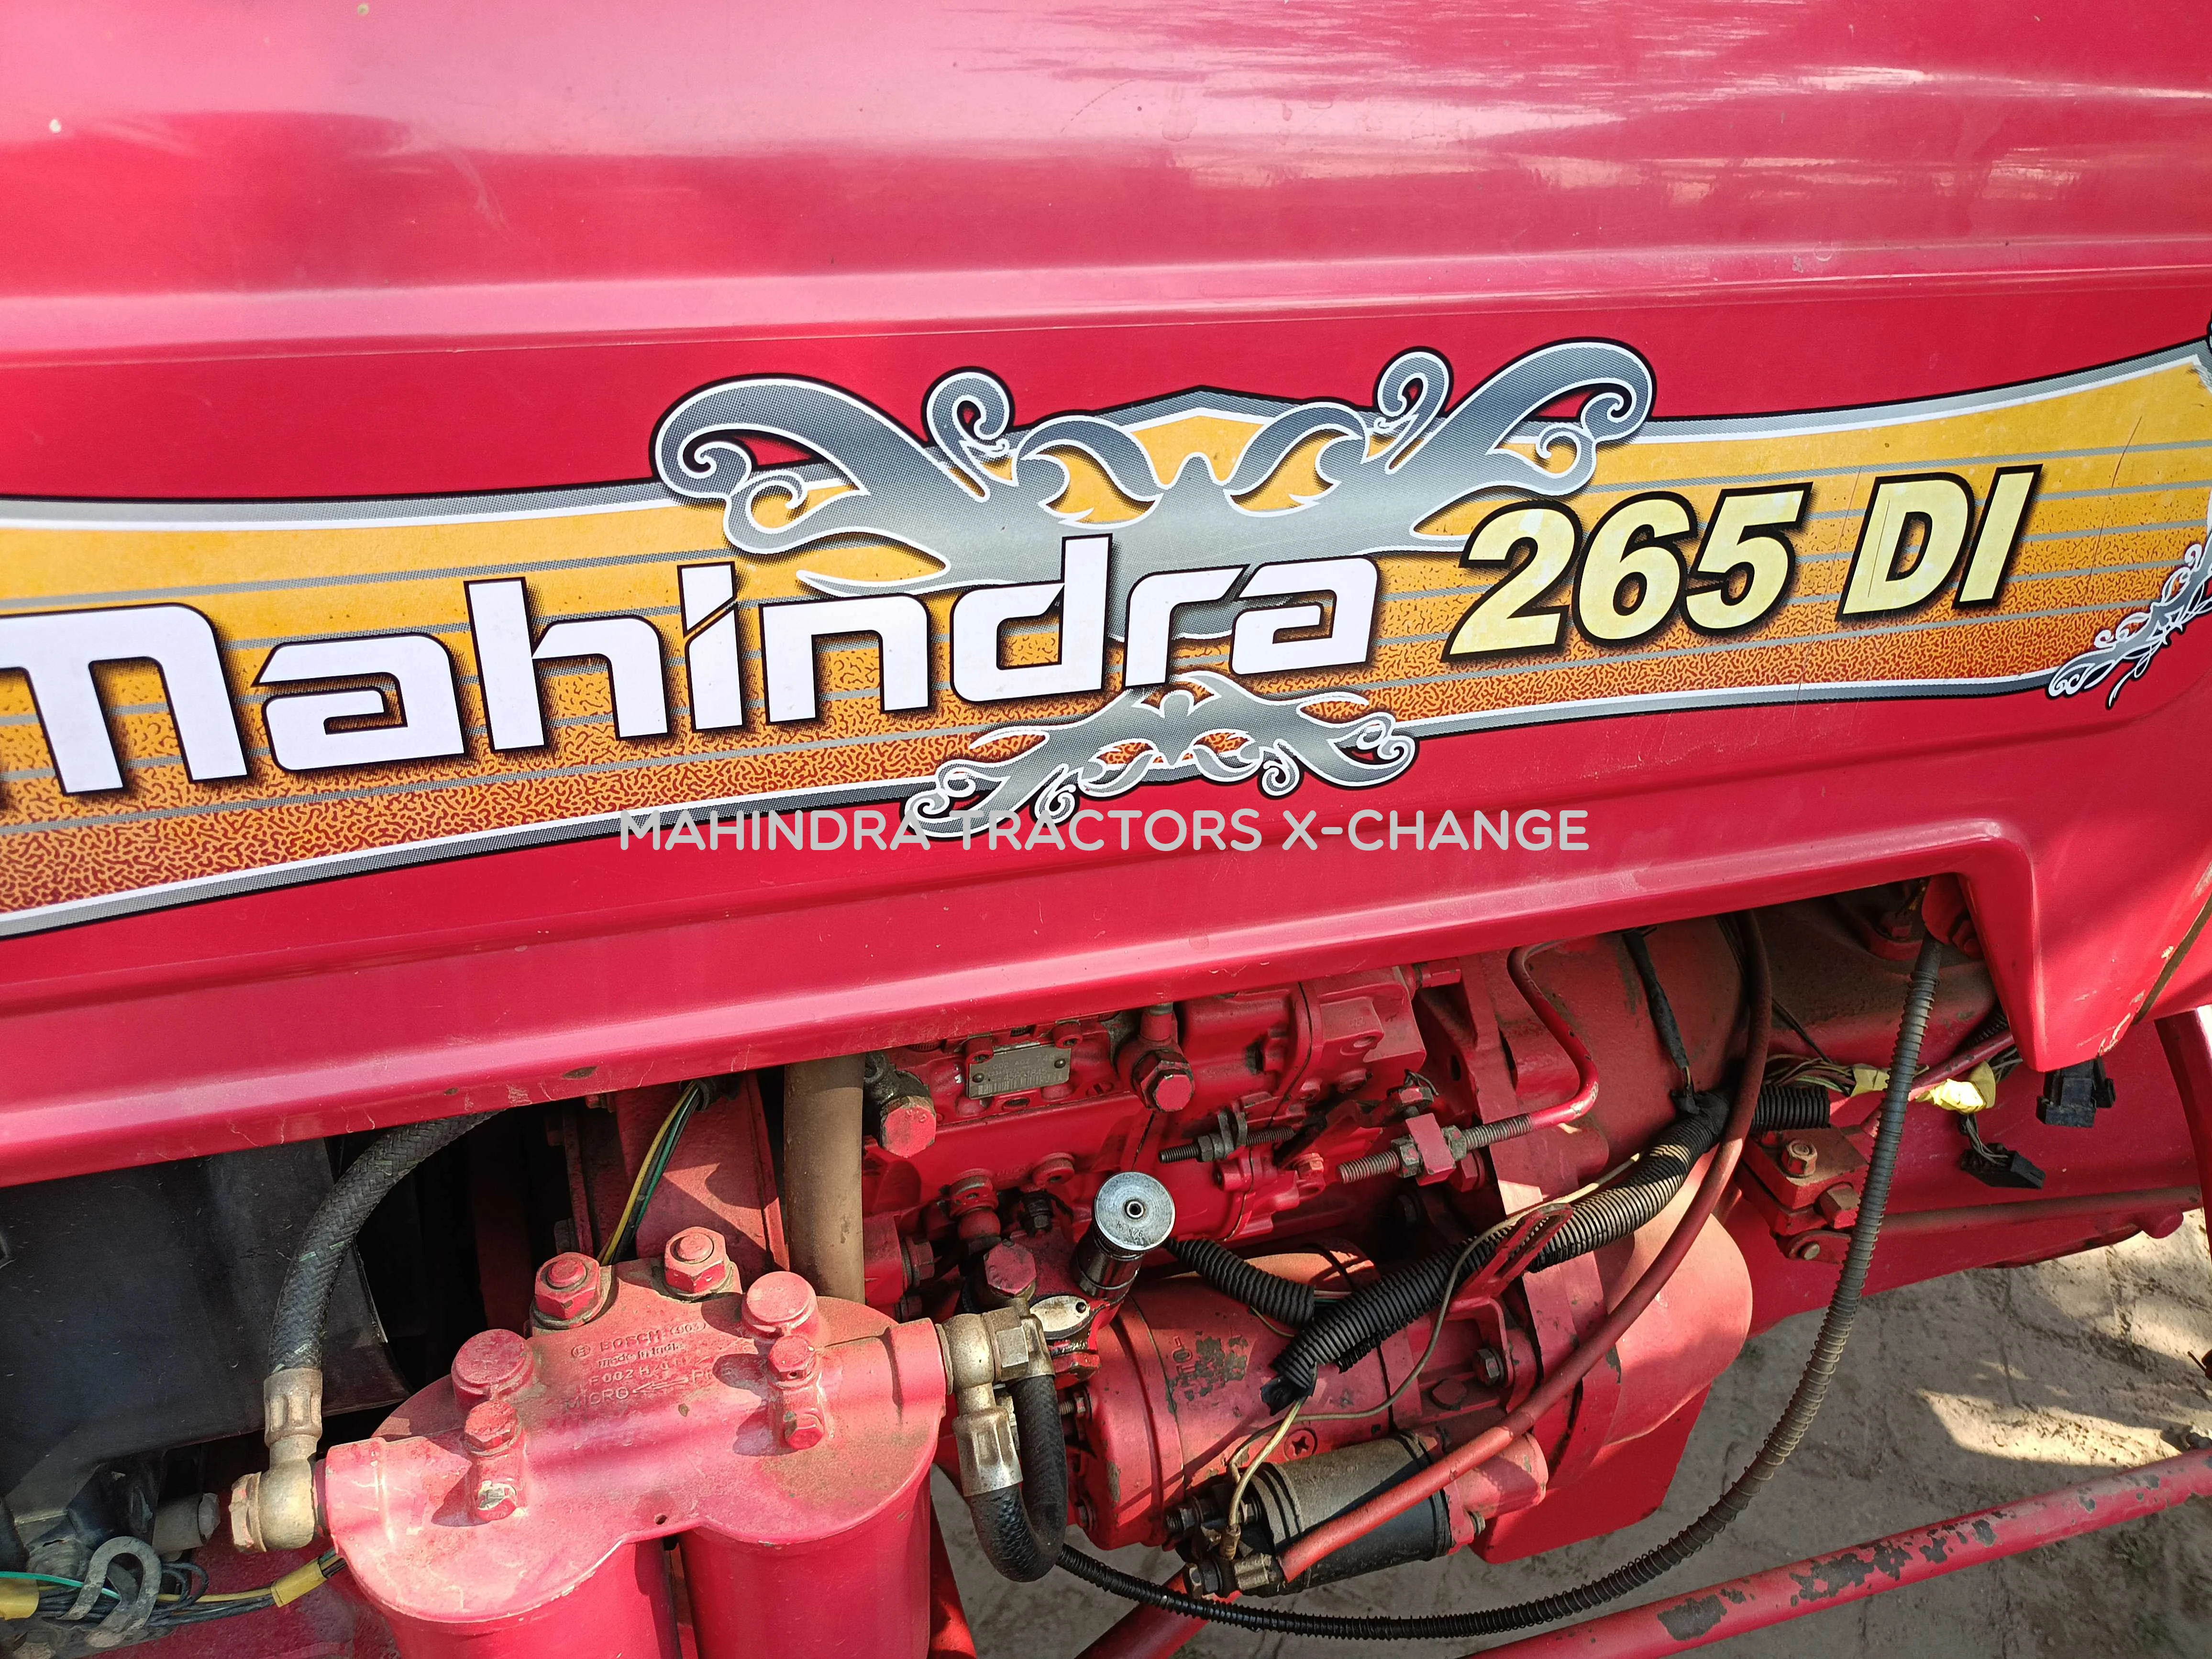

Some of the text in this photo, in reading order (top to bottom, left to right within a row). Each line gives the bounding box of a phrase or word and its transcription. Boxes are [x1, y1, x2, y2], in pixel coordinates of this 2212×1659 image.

[1440, 464, 2043, 662] 265 DI
[0, 533, 1380, 796] mahindra
[599, 1328, 662, 1352] BOSCH
